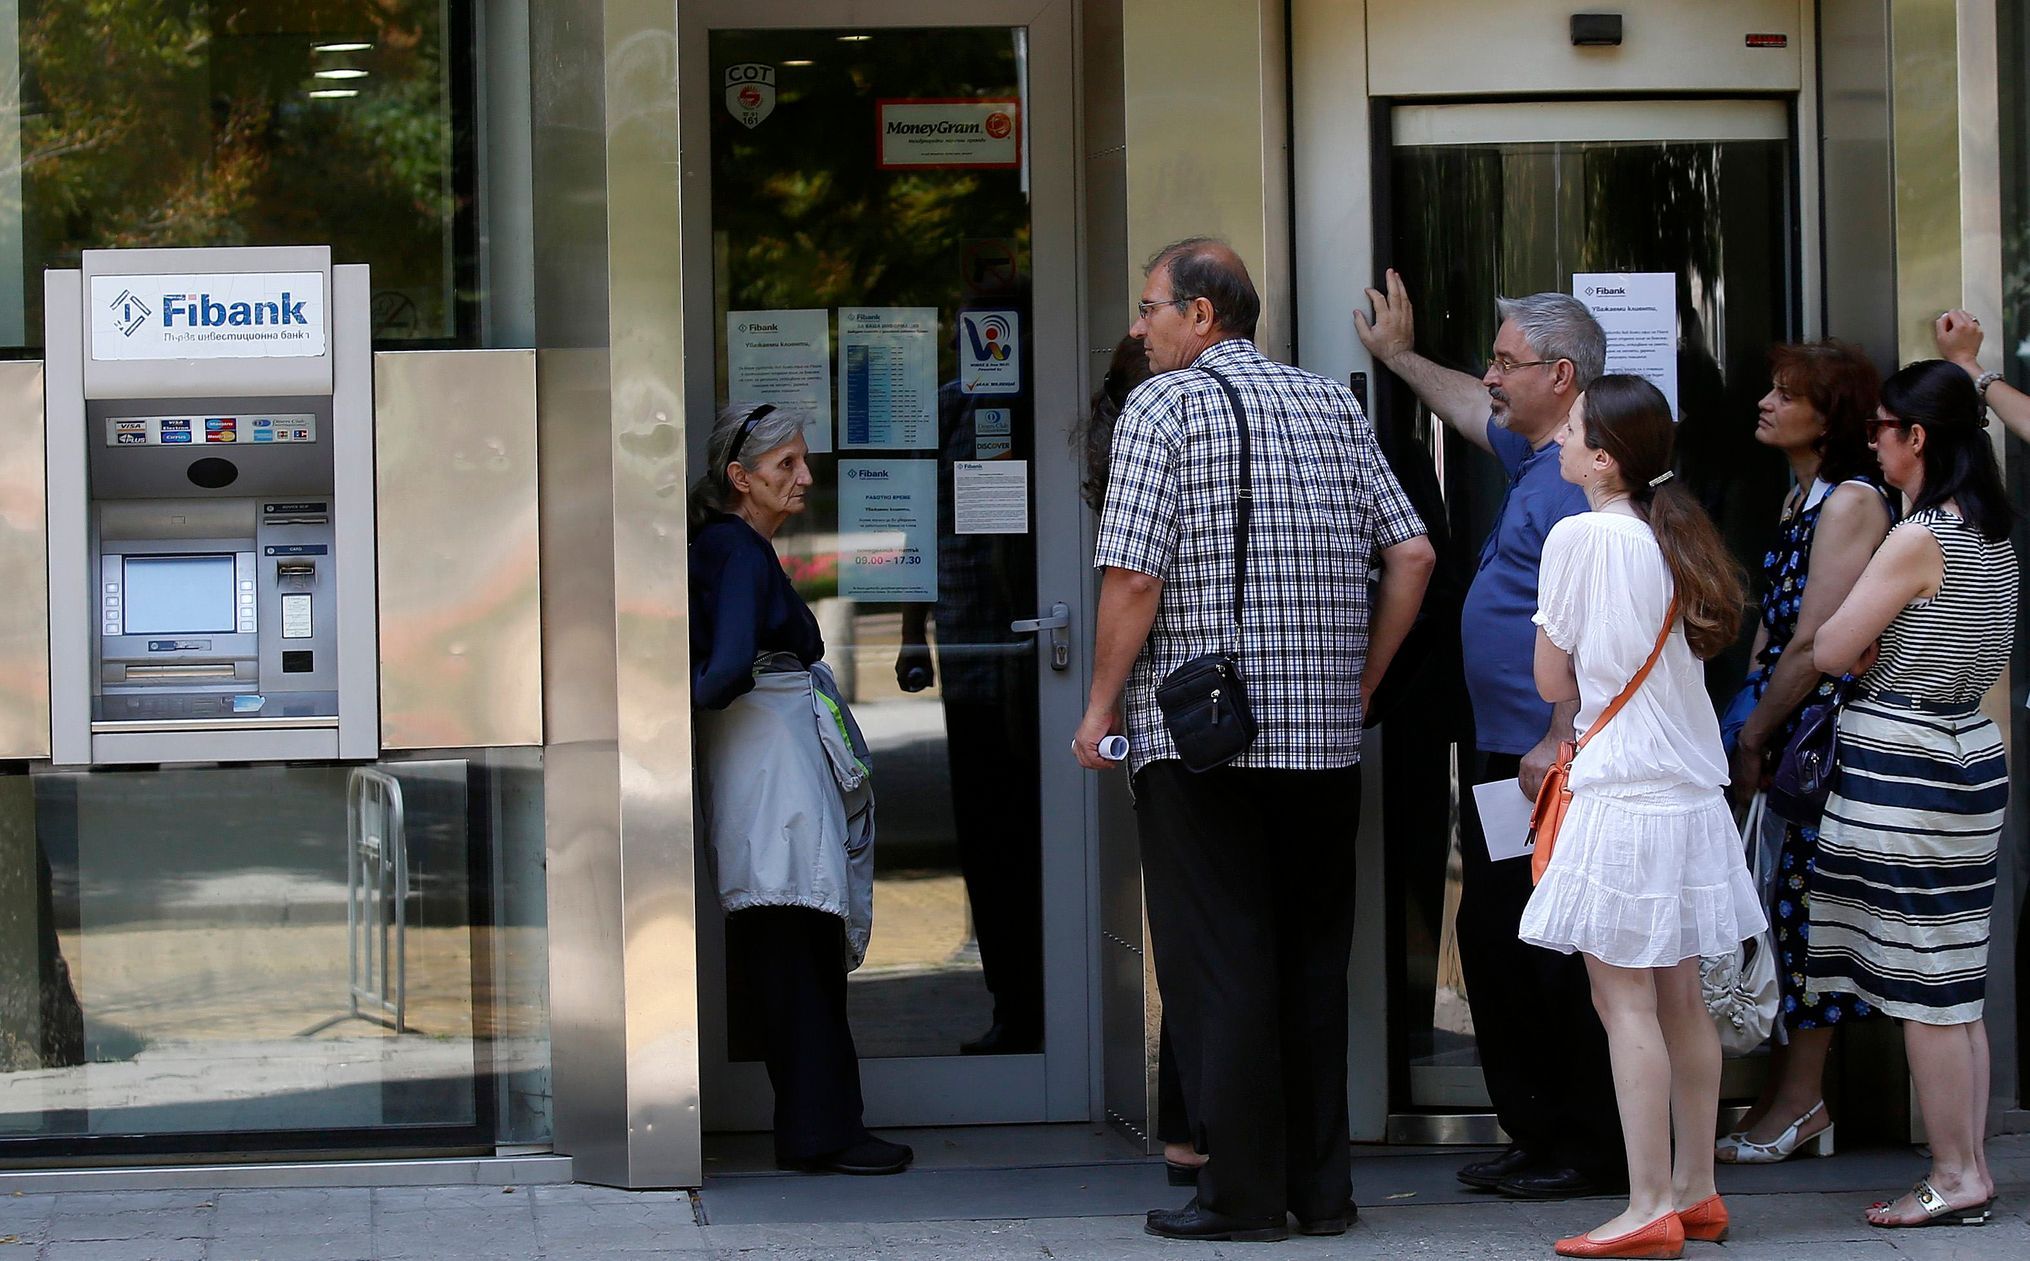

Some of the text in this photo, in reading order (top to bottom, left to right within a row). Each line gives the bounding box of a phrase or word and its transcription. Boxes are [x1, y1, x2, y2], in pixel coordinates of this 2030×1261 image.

[886, 120, 980, 137] MoneyGram
[1596, 287, 1625, 295] Fibank
[163, 292, 308, 327] Fibank
[749, 323, 778, 331] Fibank
[198, 331, 278, 342] инвестиционна
[977, 442, 1010, 450] DISCOVER
[859, 469, 888, 478] Fibank
[855, 556, 883, 565] 09.00
[894, 556, 921, 565] 17.30
